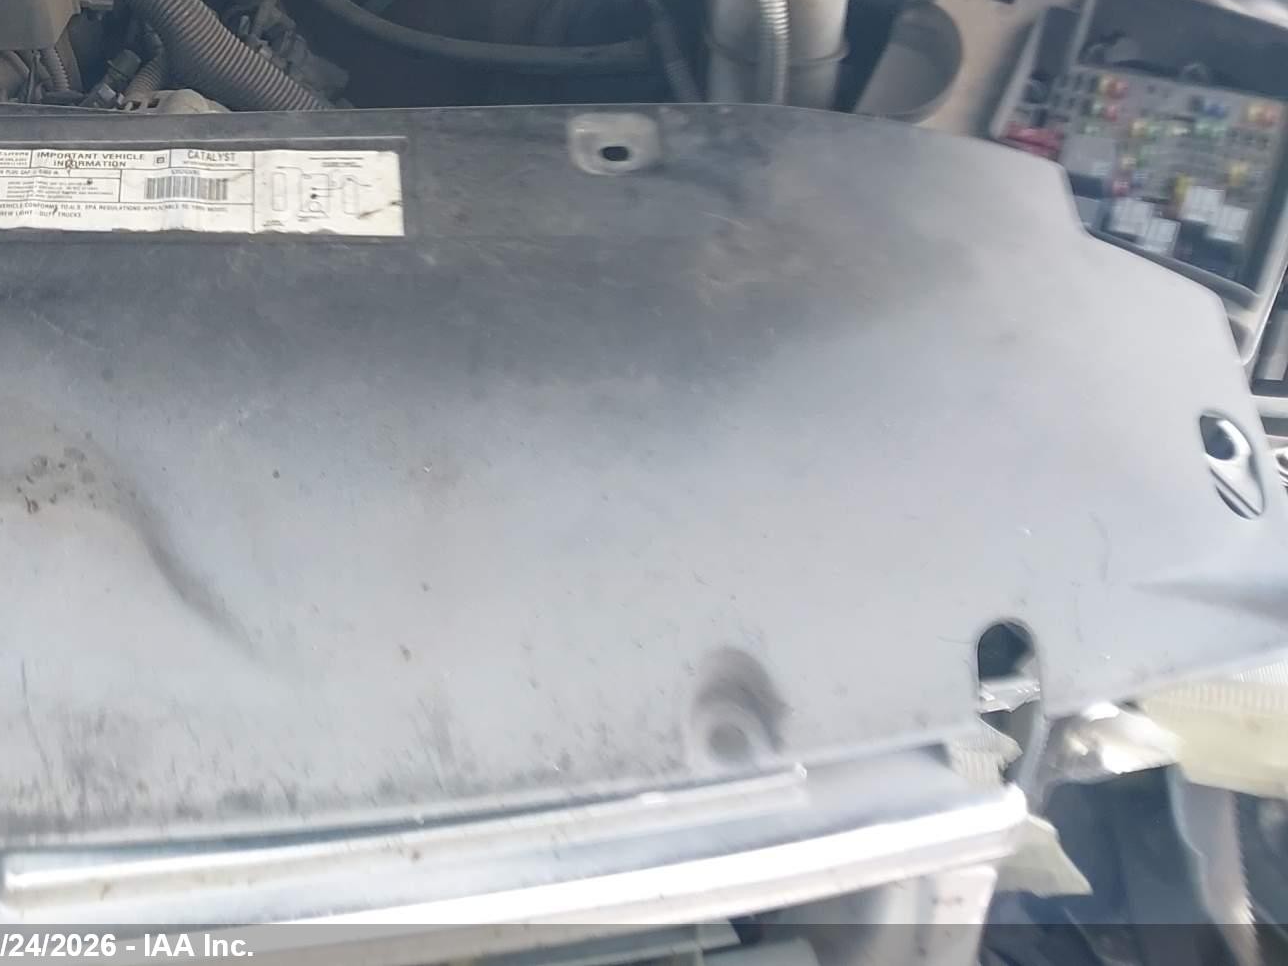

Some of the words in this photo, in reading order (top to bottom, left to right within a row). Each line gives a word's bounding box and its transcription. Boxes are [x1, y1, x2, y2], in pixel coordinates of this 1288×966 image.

[36, 151, 98, 160] IMPORTANT
[102, 152, 145, 160] VEHICLE
[187, 149, 237, 162] CATALYST
[53, 159, 127, 168] INFORMATION
